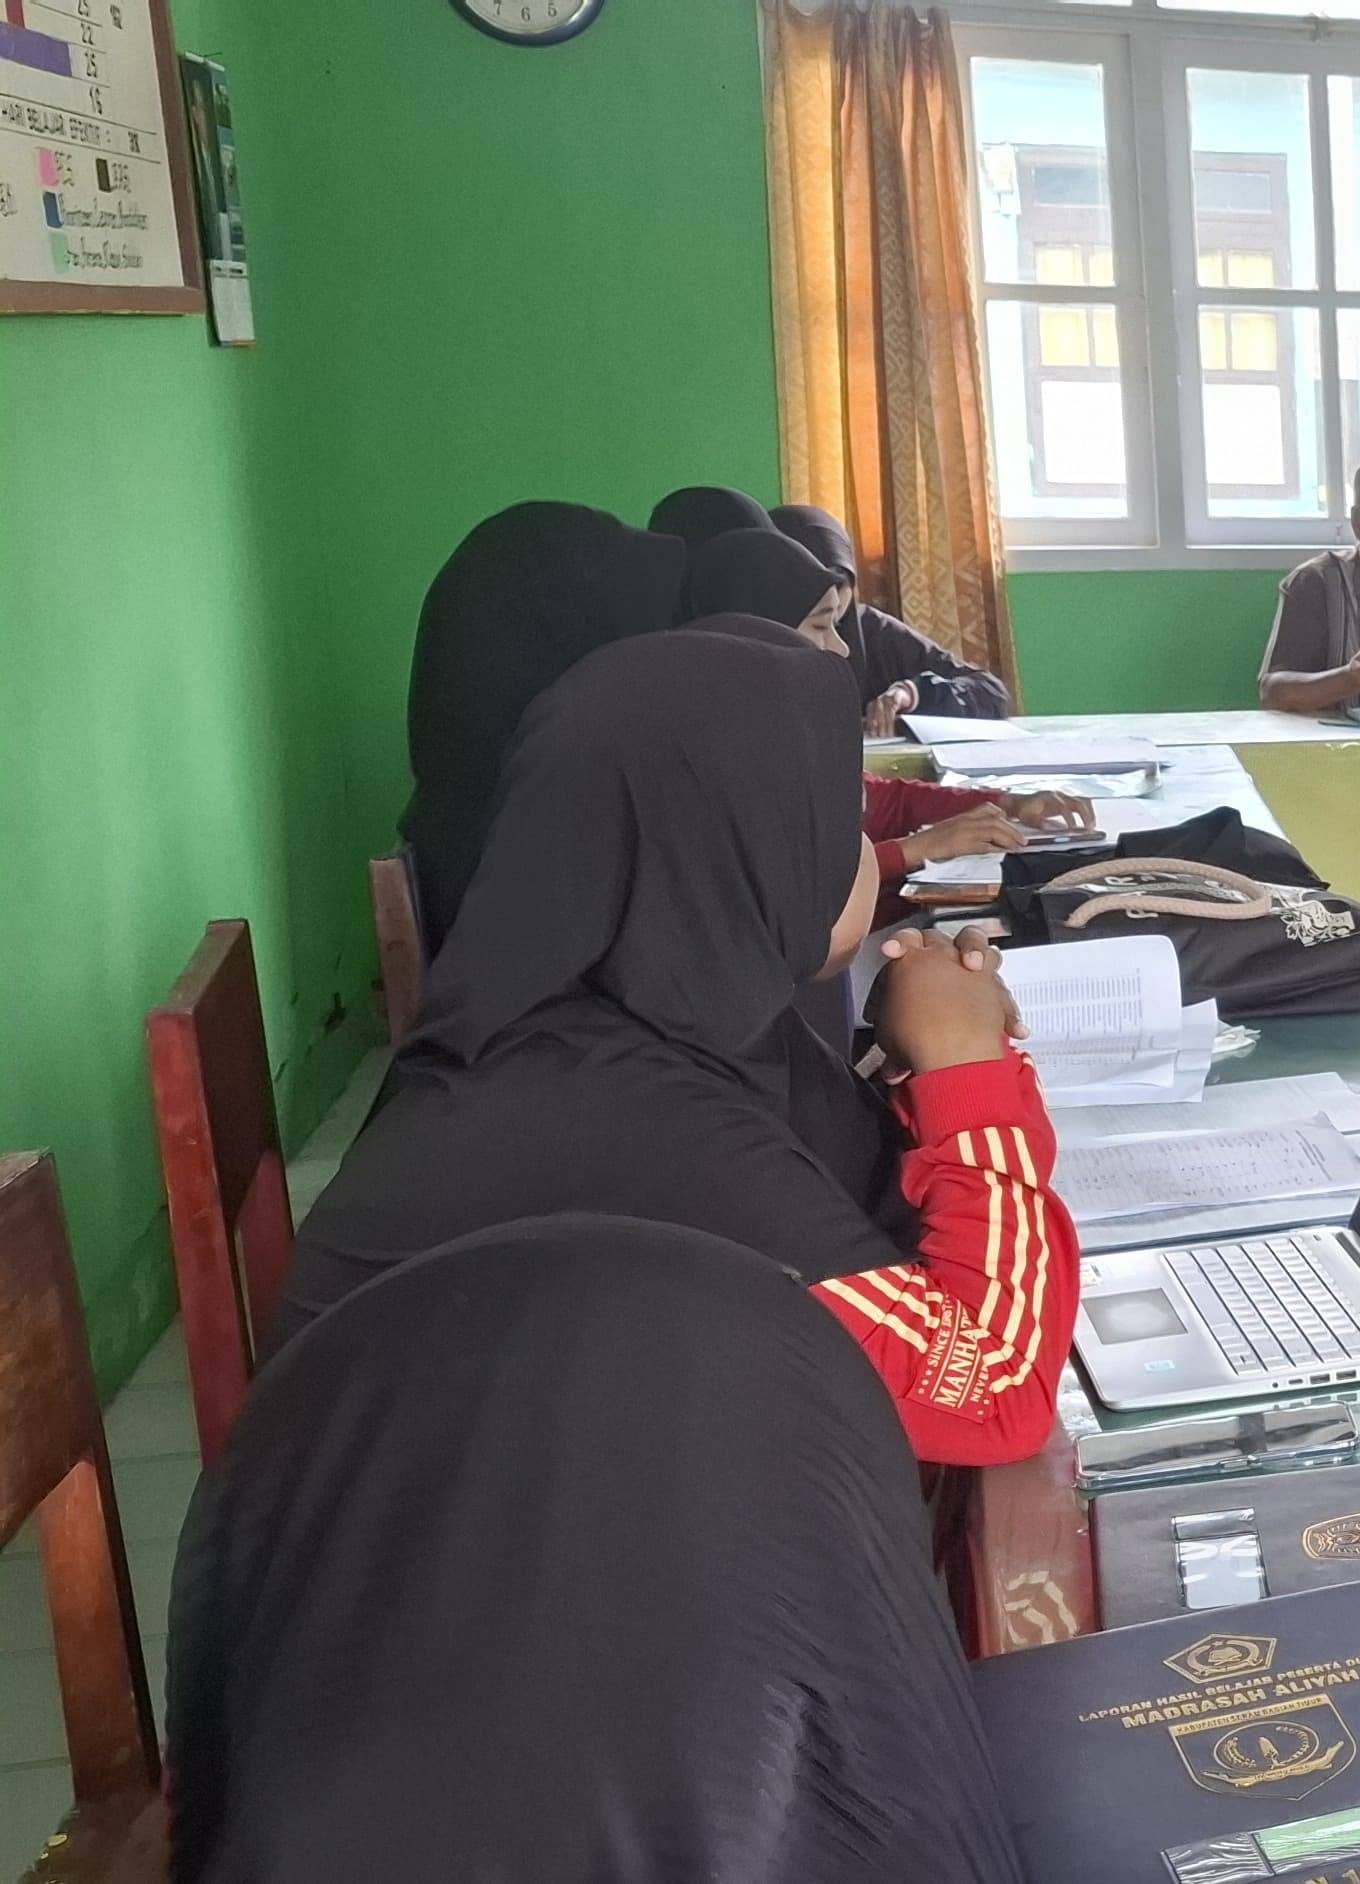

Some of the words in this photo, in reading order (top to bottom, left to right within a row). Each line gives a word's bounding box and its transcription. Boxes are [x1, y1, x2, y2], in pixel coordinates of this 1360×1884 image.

[521, 7, 531, 22] 6
[548, 3, 557, 17] 5
[927, 1328, 950, 1368] SINCE
[1079, 1700, 1152, 1723] LAPORAN
[1157, 1690, 1203, 1706] HASIL
[1207, 1676, 1274, 1697] BELAJAR
[1277, 1661, 1341, 1681] PESERTA
[1121, 1689, 1267, 1729] MADRASAH
[1273, 1669, 1360, 1697] ALIYAH
[1176, 1719, 1230, 1734] KABUPATEN
